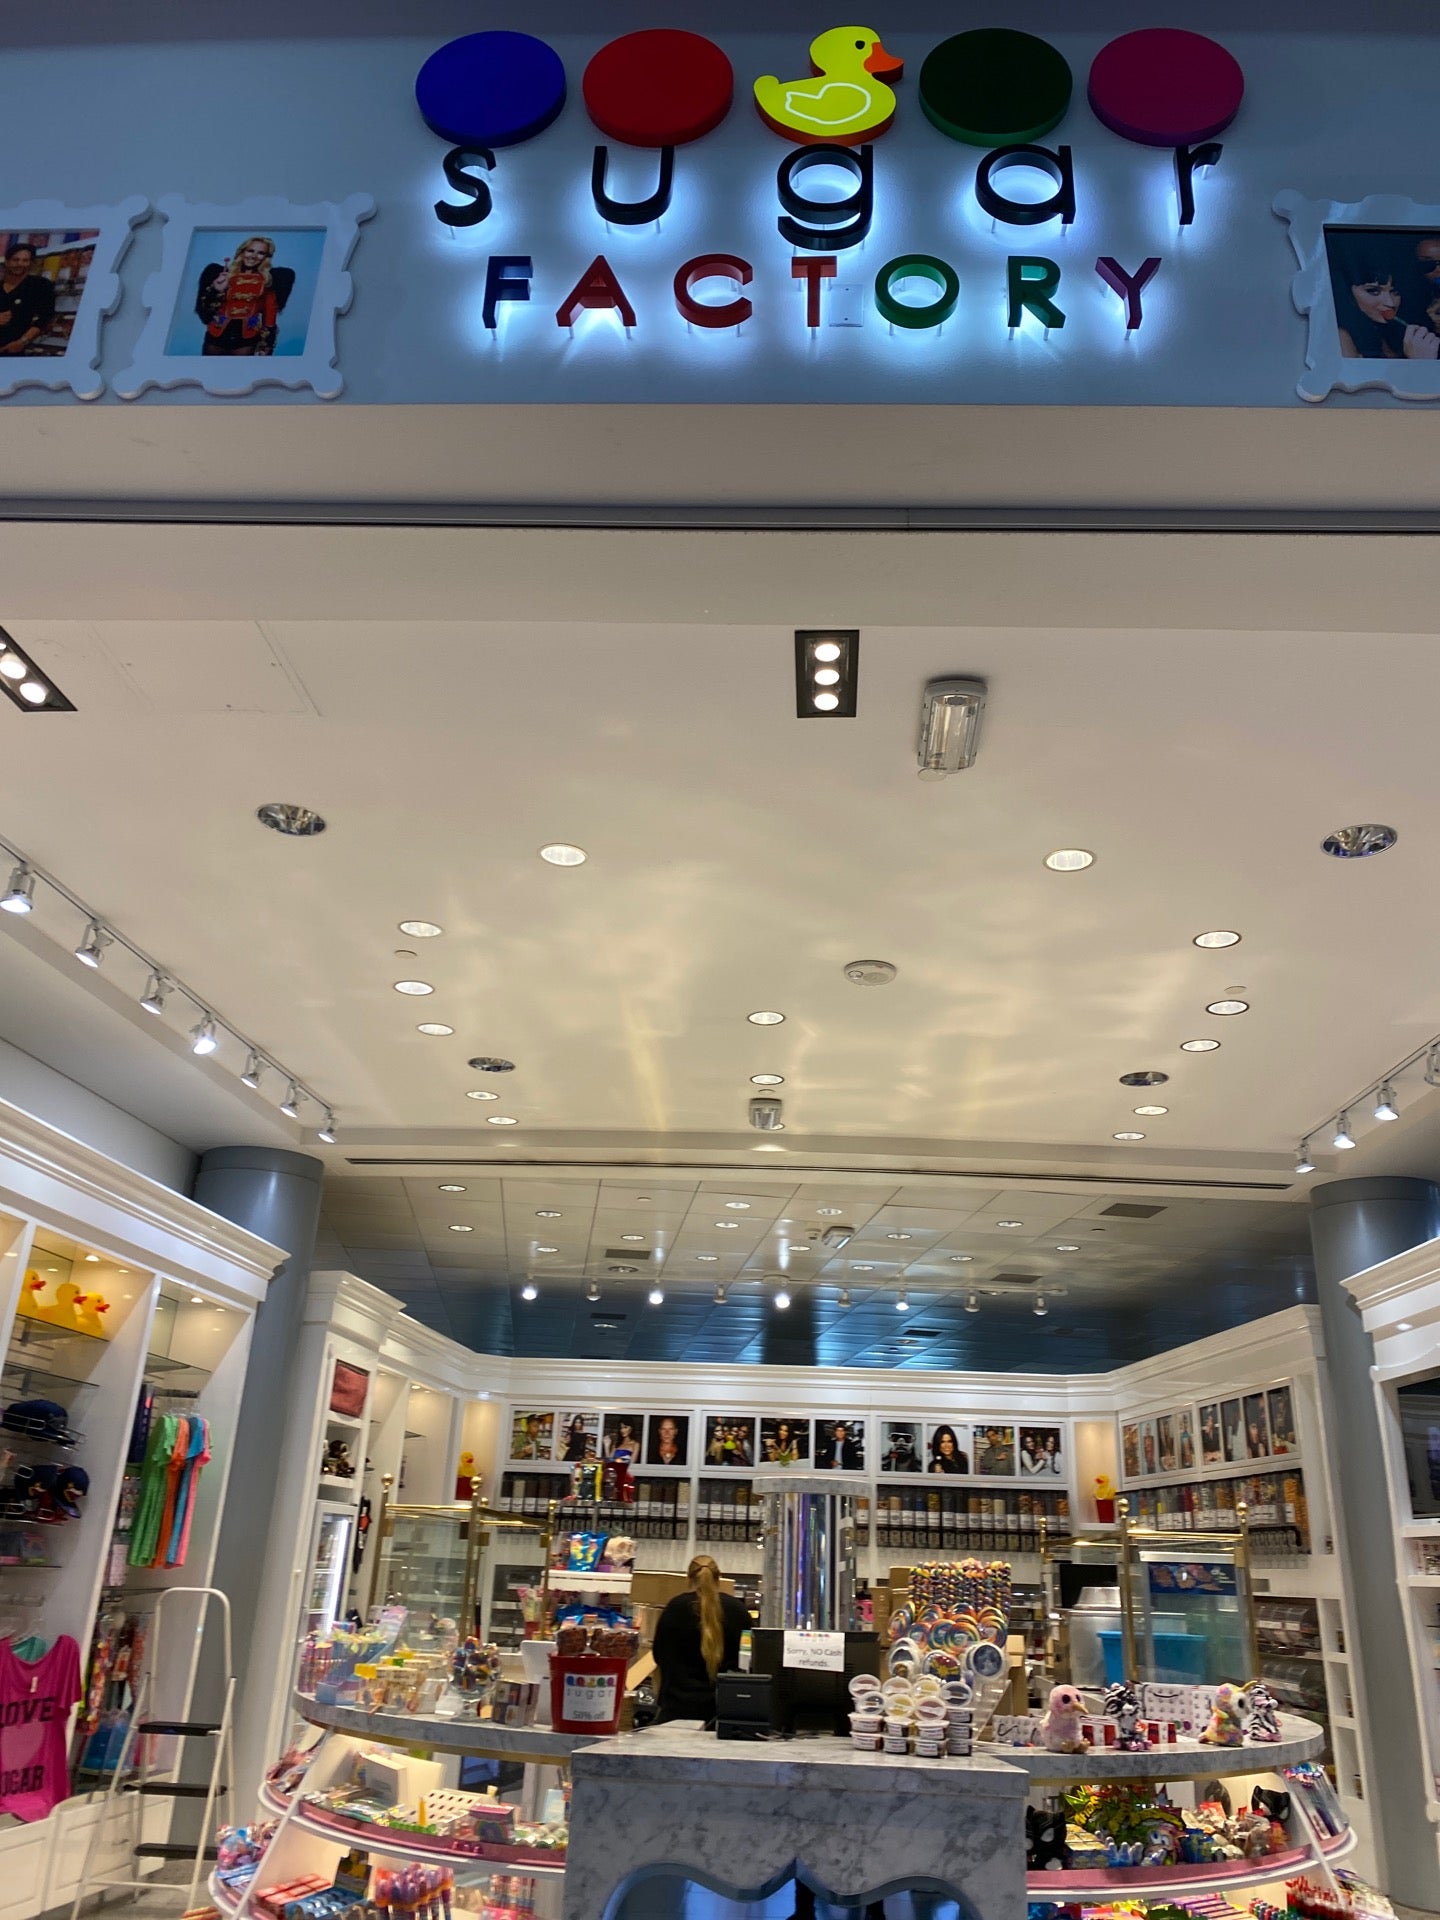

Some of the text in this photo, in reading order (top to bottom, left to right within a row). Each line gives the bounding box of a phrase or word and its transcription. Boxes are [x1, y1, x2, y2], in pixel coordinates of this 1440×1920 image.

[434, 143, 1223, 250] sugar
[482, 253, 1162, 329] FACTORY
[786, 1647, 842, 1657] Sorry, NO Cash
